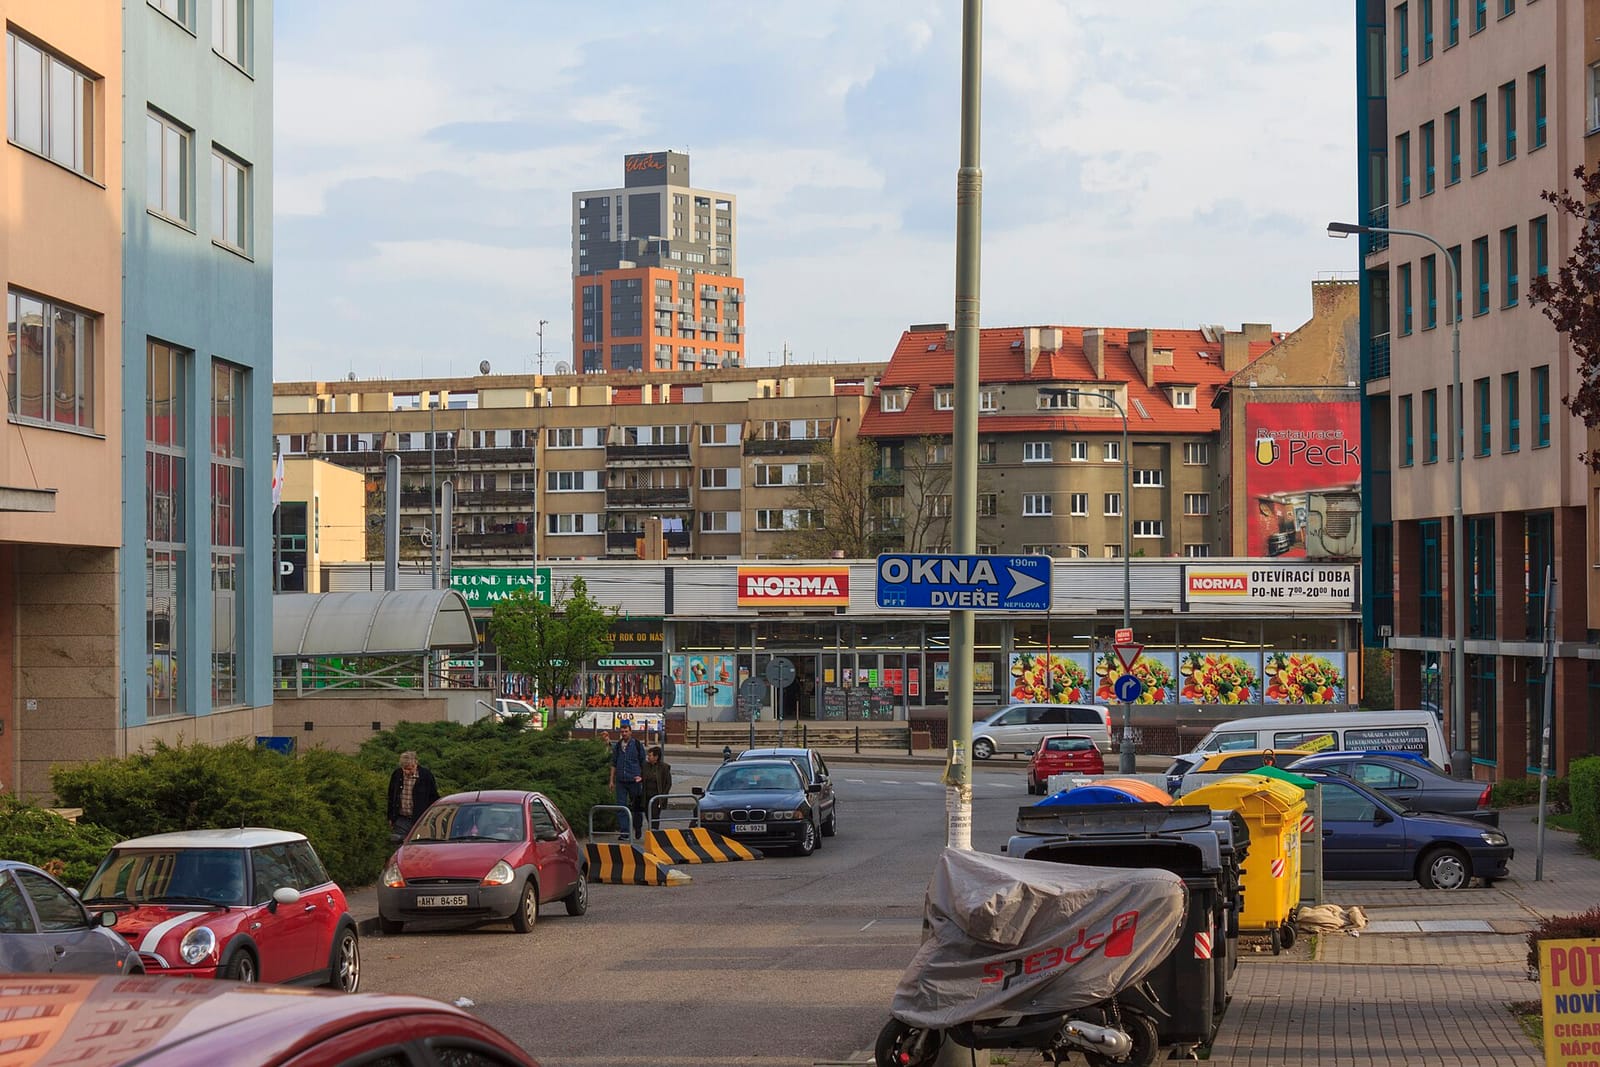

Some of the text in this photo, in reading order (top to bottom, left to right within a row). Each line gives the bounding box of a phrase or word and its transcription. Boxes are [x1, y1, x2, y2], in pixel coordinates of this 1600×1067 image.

[1257, 428, 1343, 440] Restaurace
[1009, 559, 1037, 567] 190m
[881, 558, 998, 584] OKNA
[1252, 569, 1351, 582] OTEVÍRACÍ DOBA
[507, 575, 546, 585] HAND
[1193, 579, 1243, 589] NORMA
[746, 577, 841, 596] NORMA
[931, 589, 999, 607] DVEŘE
[1252, 588, 1284, 598] PO-NE
[1331, 587, 1350, 597] hod
[619, 633, 634, 642] ROK
[636, 633, 647, 642] OD
[421, 897, 435, 905] AHY
